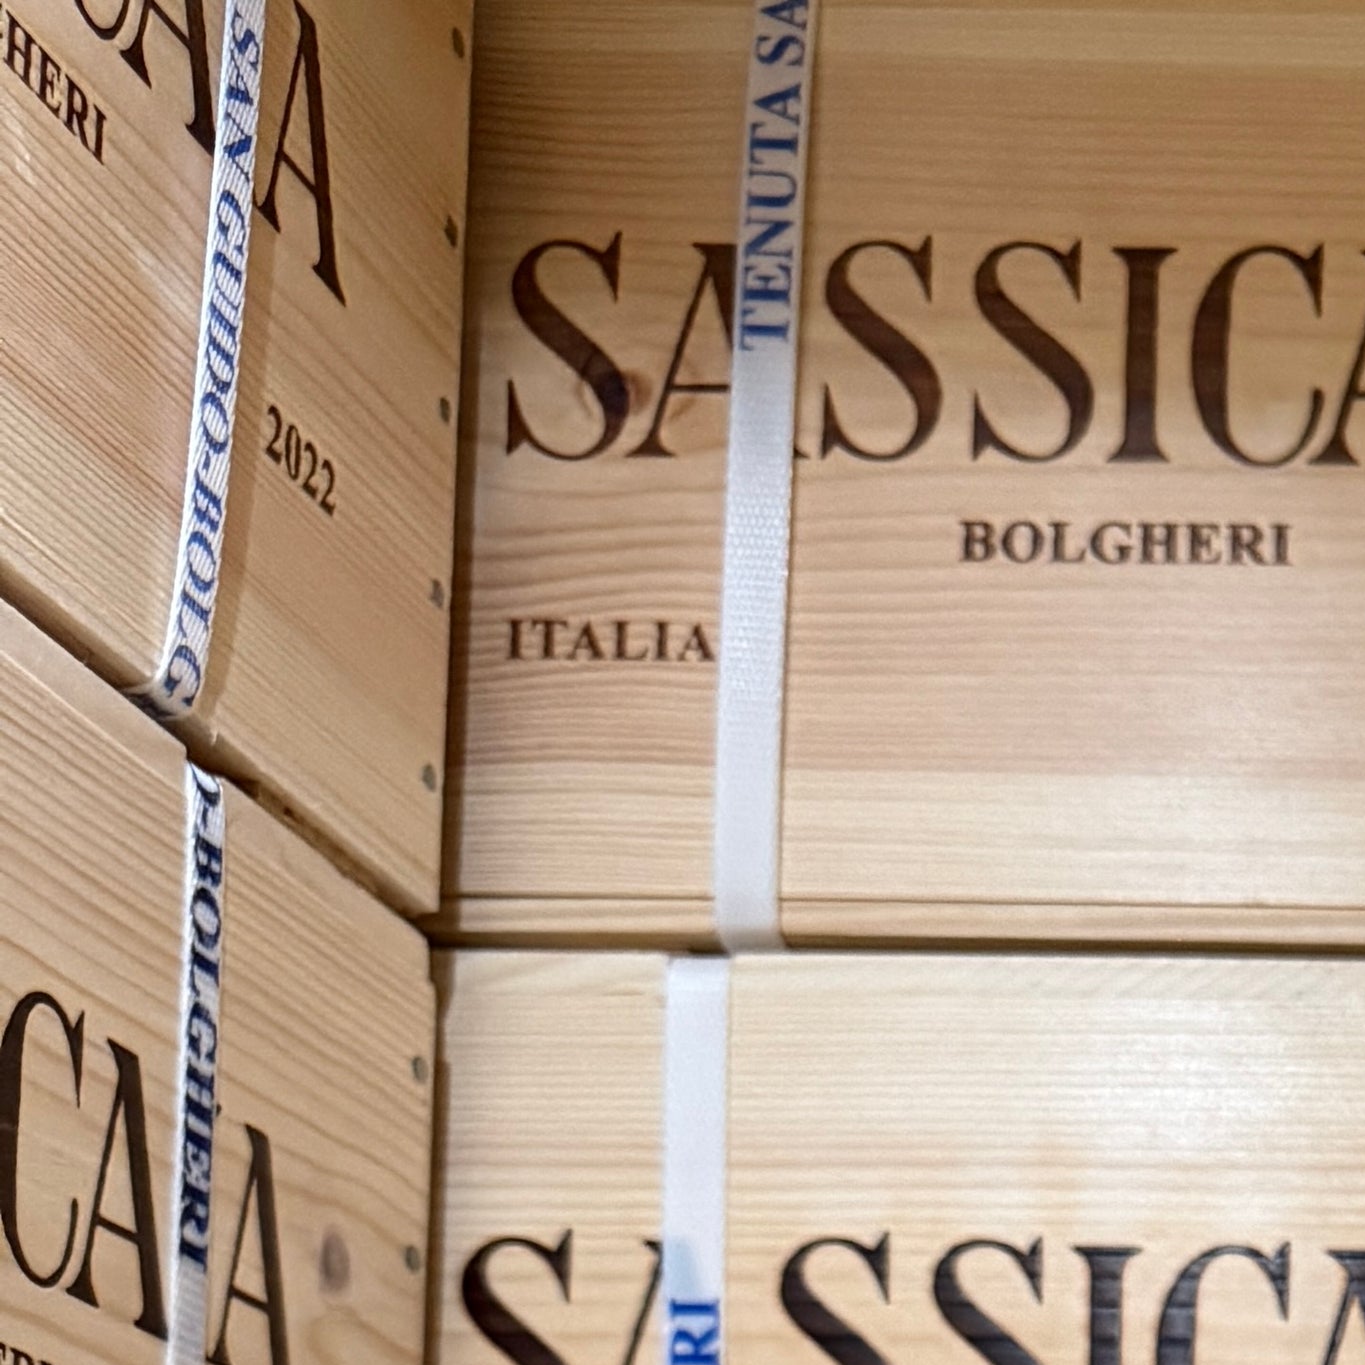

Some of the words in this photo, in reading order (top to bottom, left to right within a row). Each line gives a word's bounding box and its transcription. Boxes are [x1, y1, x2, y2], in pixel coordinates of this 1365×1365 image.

[741, 85, 800, 352] TENUTA
[264, 404, 337, 517] 2022
[959, 520, 1293, 567] BOLGHERI
[505, 617, 715, 663] ITALIA
